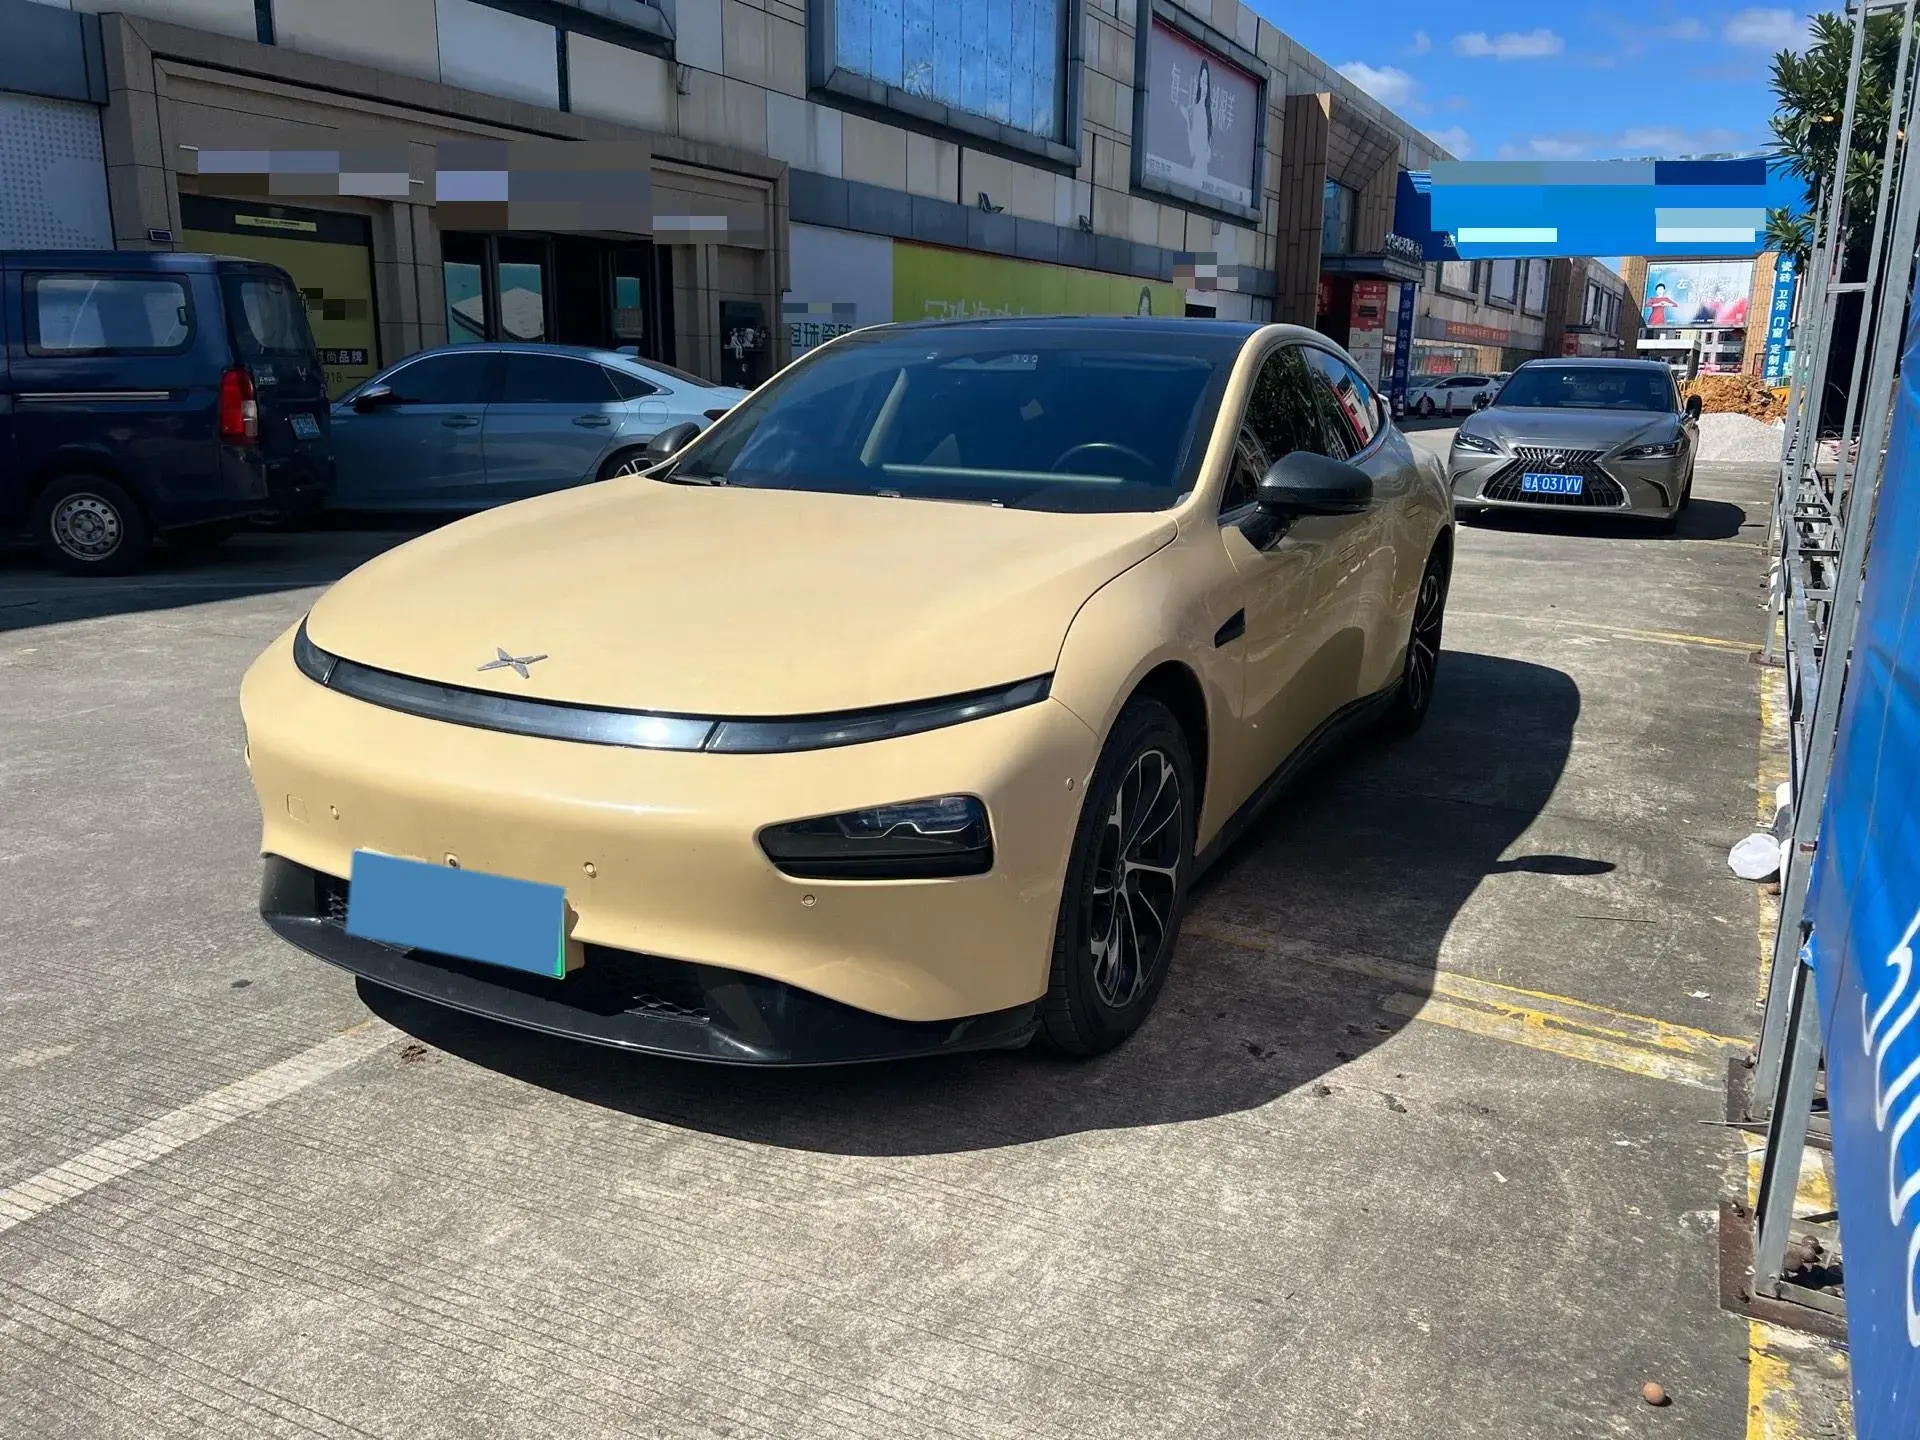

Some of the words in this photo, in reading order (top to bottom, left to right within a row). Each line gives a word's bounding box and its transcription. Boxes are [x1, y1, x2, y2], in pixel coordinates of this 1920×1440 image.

[1779, 261, 1792, 283] 瓷砖
[1775, 289, 1788, 311] 卫浴
[1772, 317, 1785, 338] 门窗
